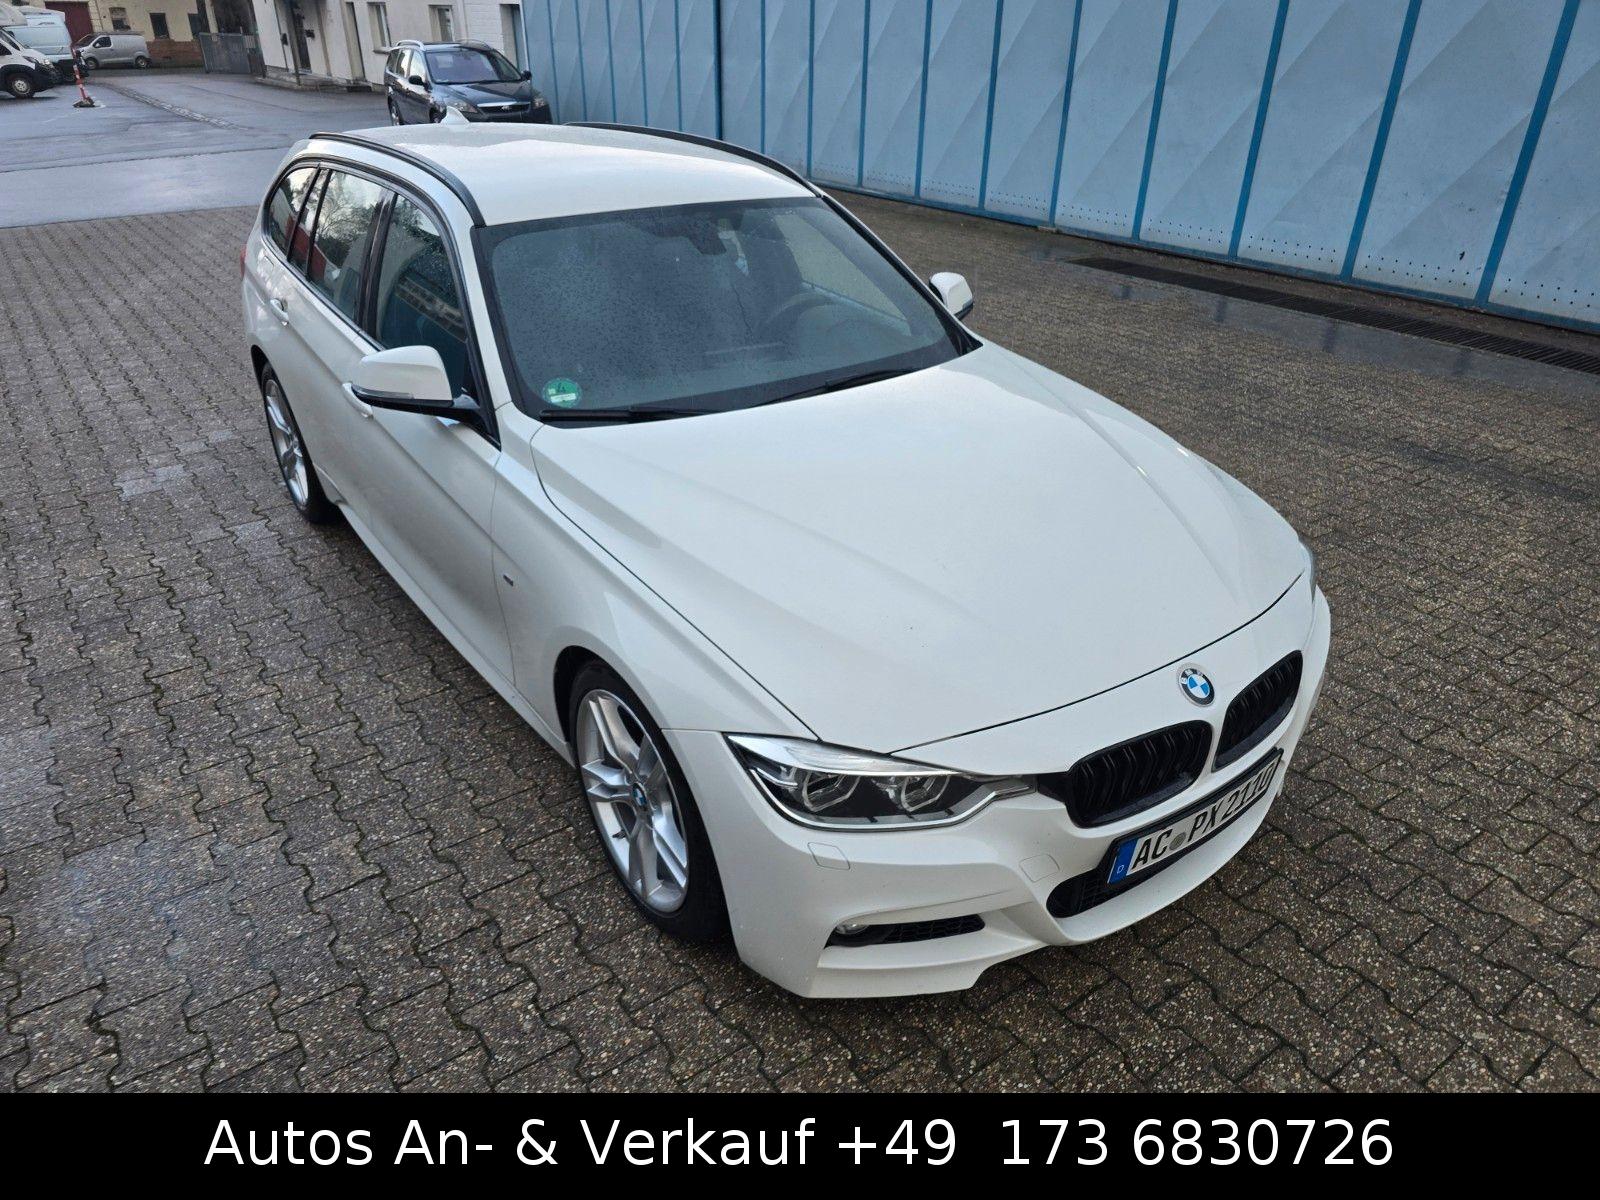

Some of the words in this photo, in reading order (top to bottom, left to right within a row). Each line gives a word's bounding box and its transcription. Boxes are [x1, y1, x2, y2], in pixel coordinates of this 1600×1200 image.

[1131, 829, 1173, 870] AC
[1187, 801, 1222, 842] PX
[1221, 762, 1274, 821] 2110
